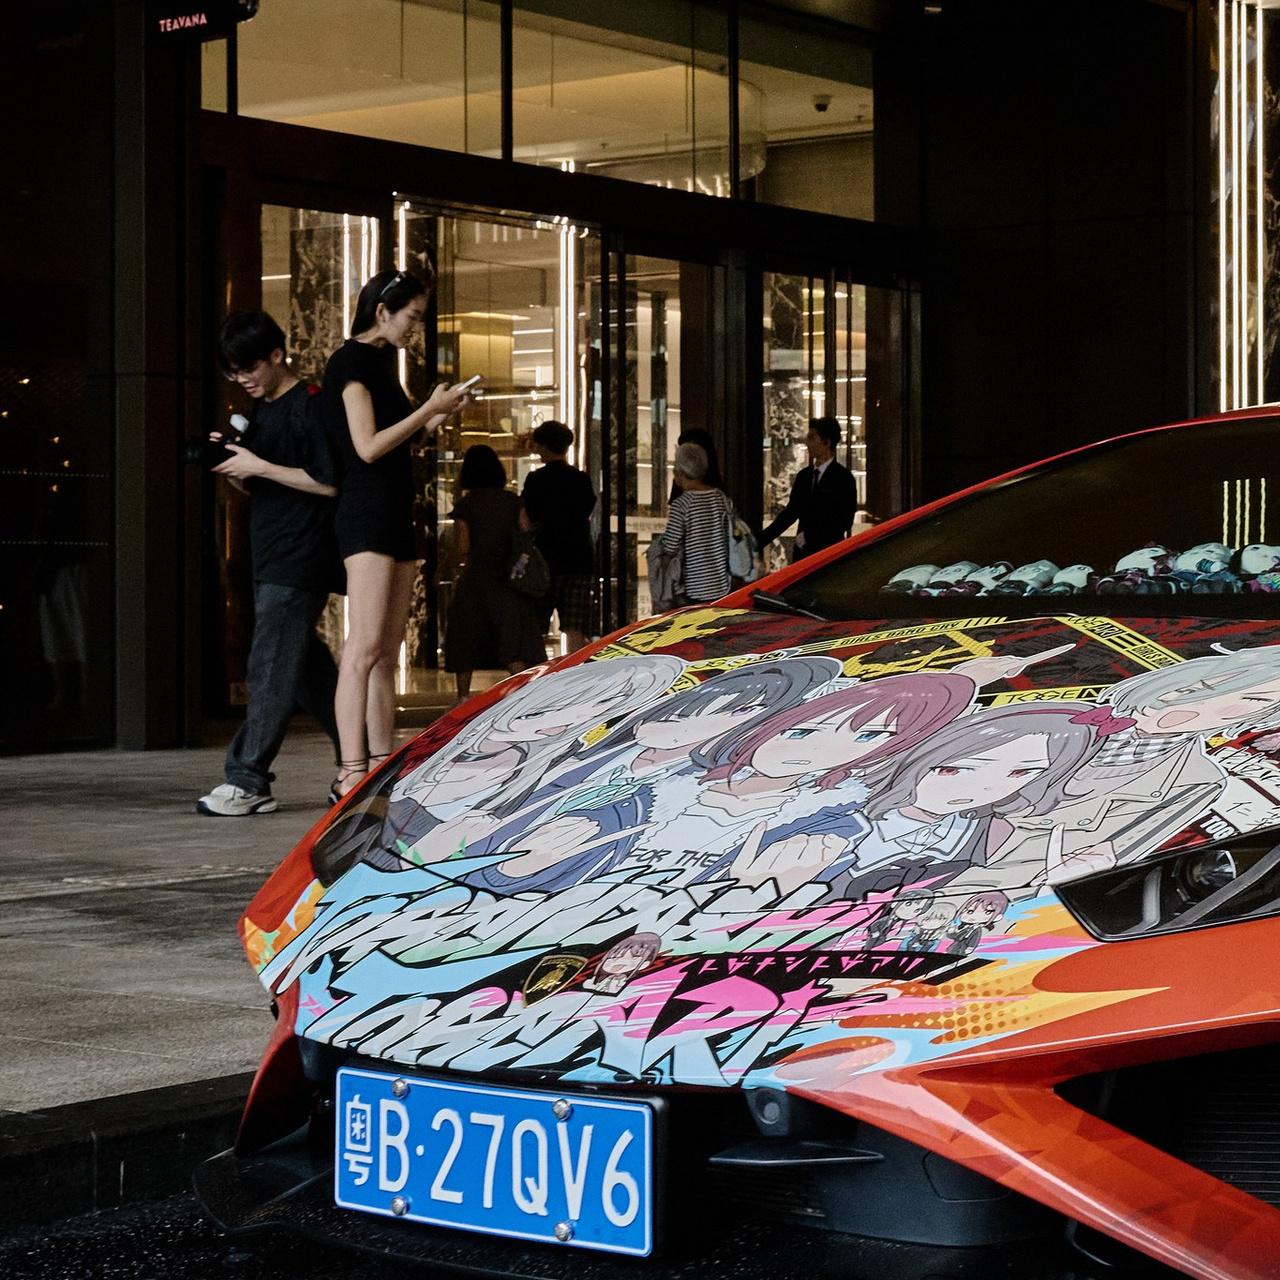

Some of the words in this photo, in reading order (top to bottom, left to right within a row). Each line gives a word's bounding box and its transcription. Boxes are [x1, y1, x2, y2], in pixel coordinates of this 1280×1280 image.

[158, 12, 208, 33] TEAVANA
[839, 632, 882, 646] GIRLS
[885, 626, 926, 639] BAND
[930, 621, 963, 631] CRY
[627, 847, 672, 864] FOR
[675, 849, 723, 869] THE
